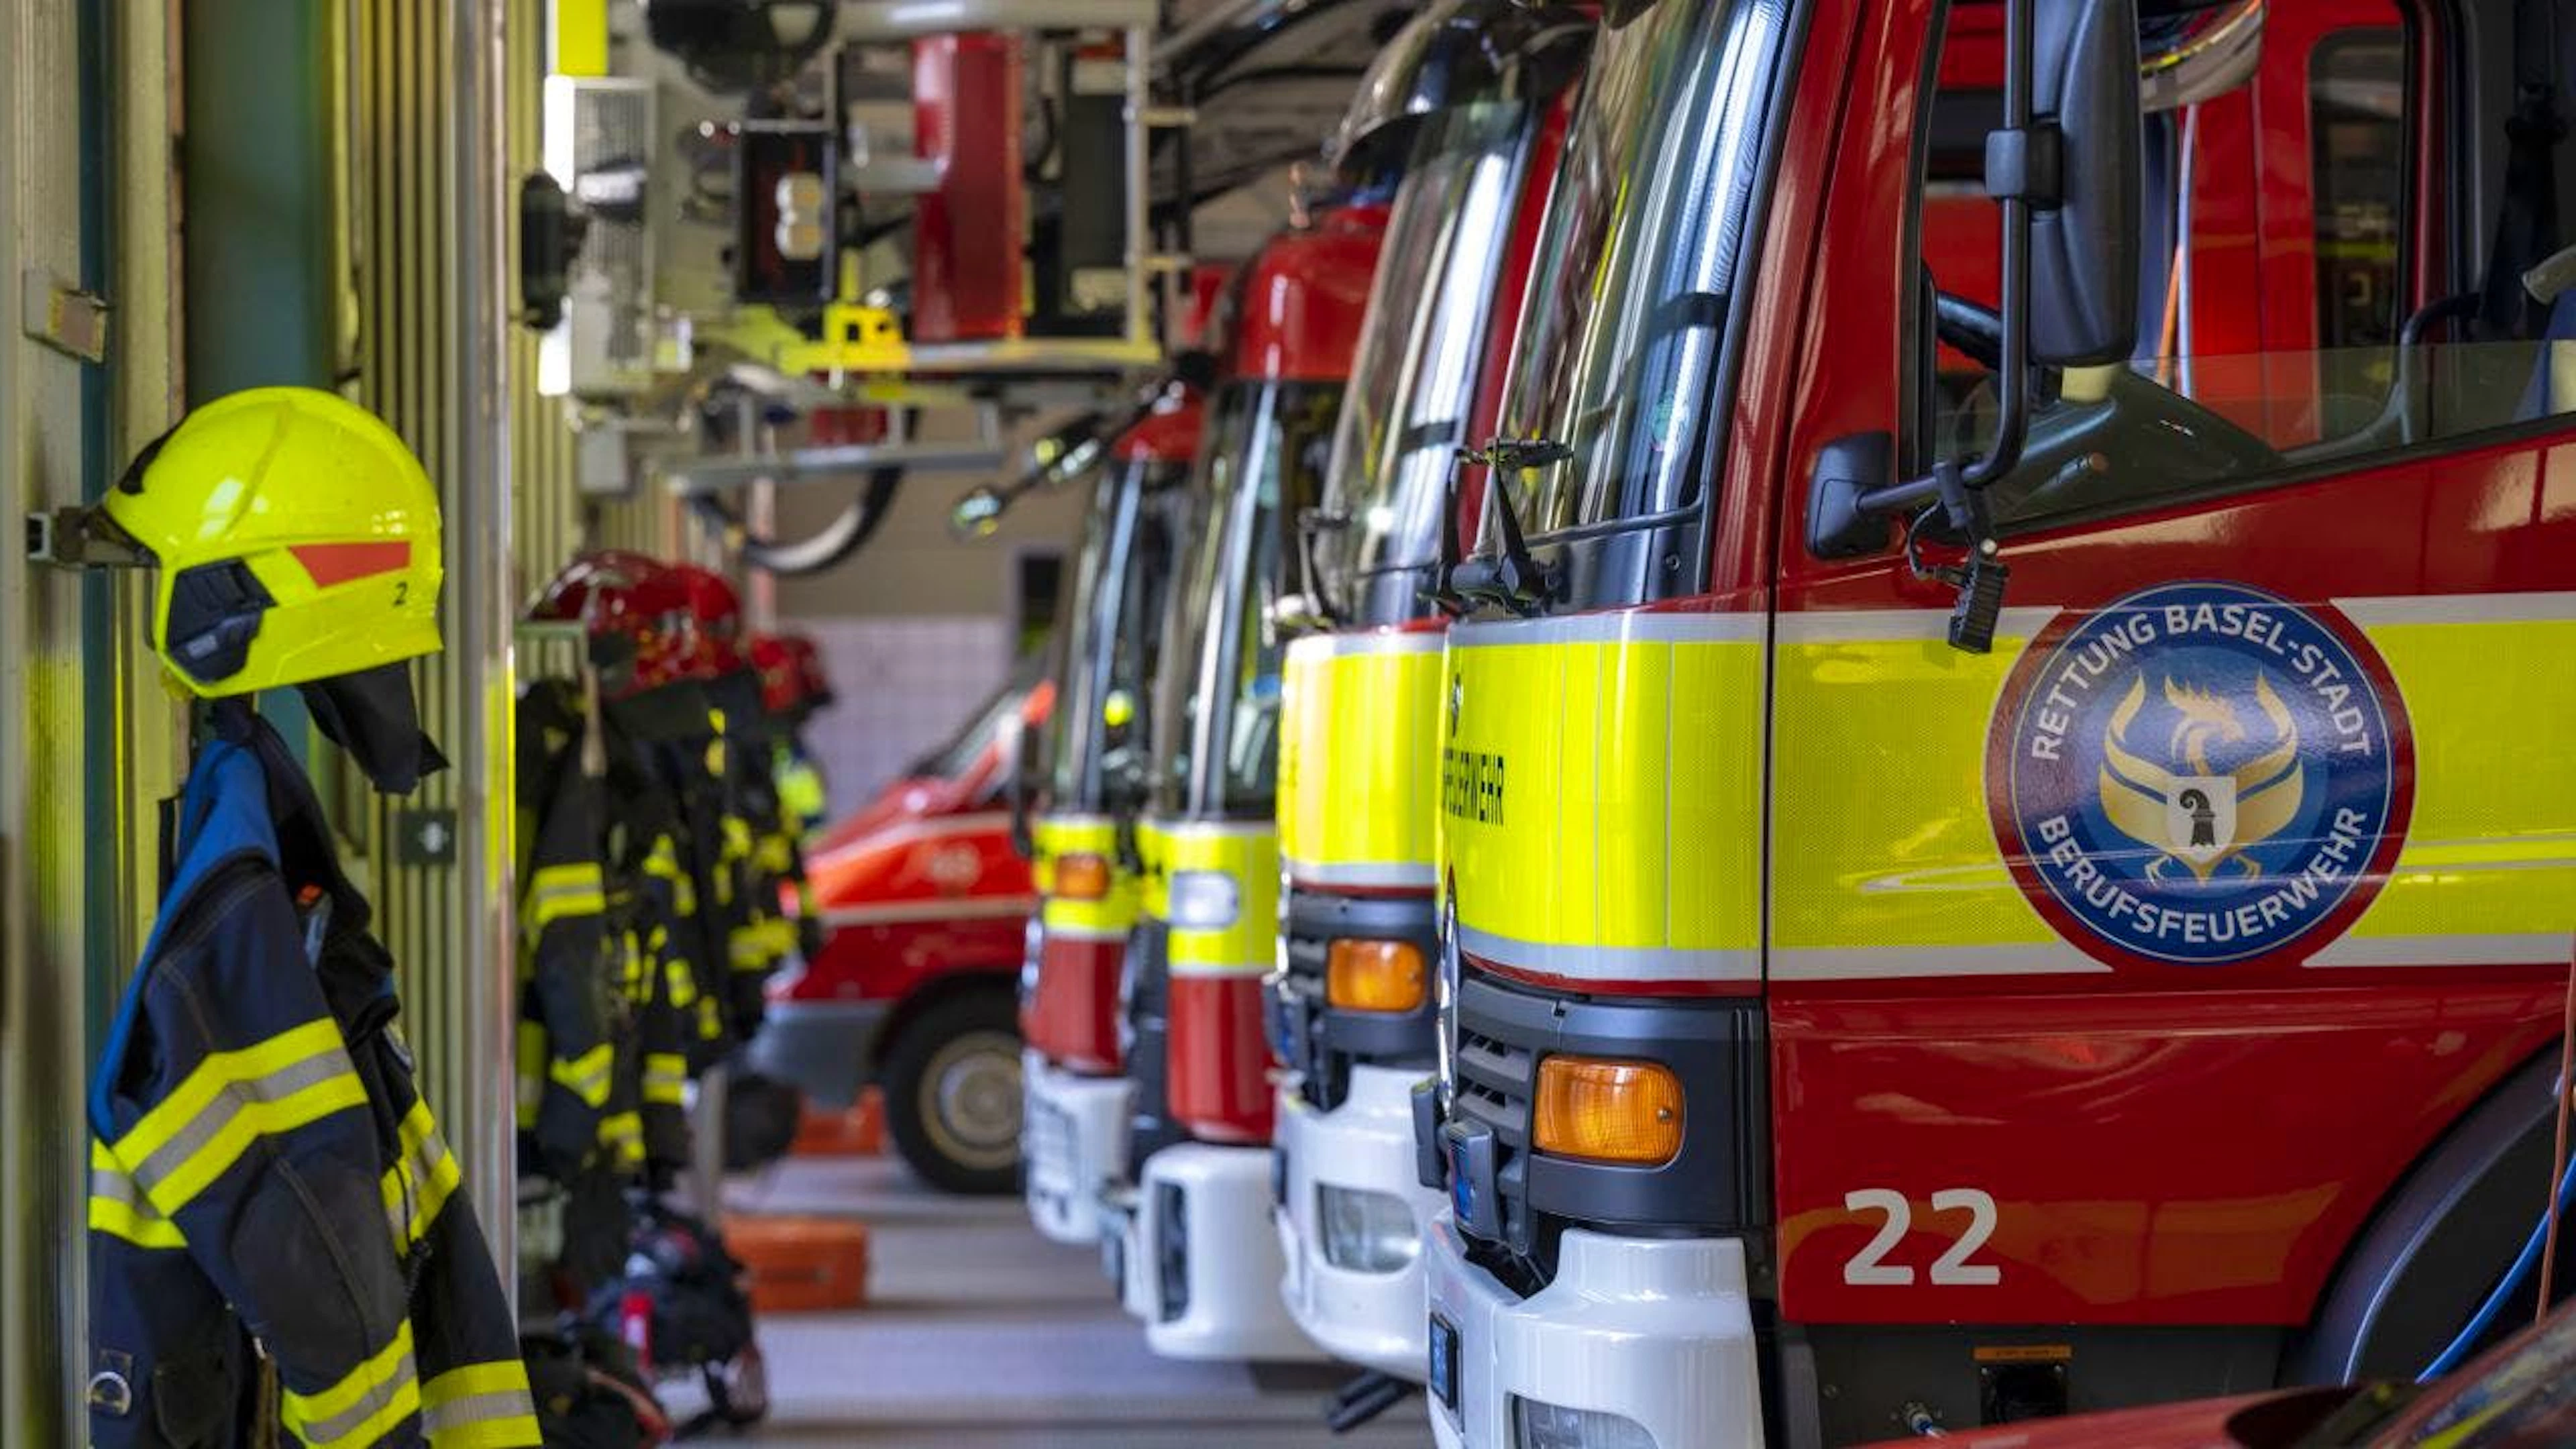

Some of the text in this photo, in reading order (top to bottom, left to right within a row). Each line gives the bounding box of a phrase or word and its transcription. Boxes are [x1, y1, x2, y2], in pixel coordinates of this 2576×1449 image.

[393, 581, 407, 608] 2
[2032, 604, 2370, 760] RETTUNG BASEL-STADT
[2040, 807, 2366, 943] BERUFSFEUERWEHR
[1844, 1189, 2000, 1285] 22
